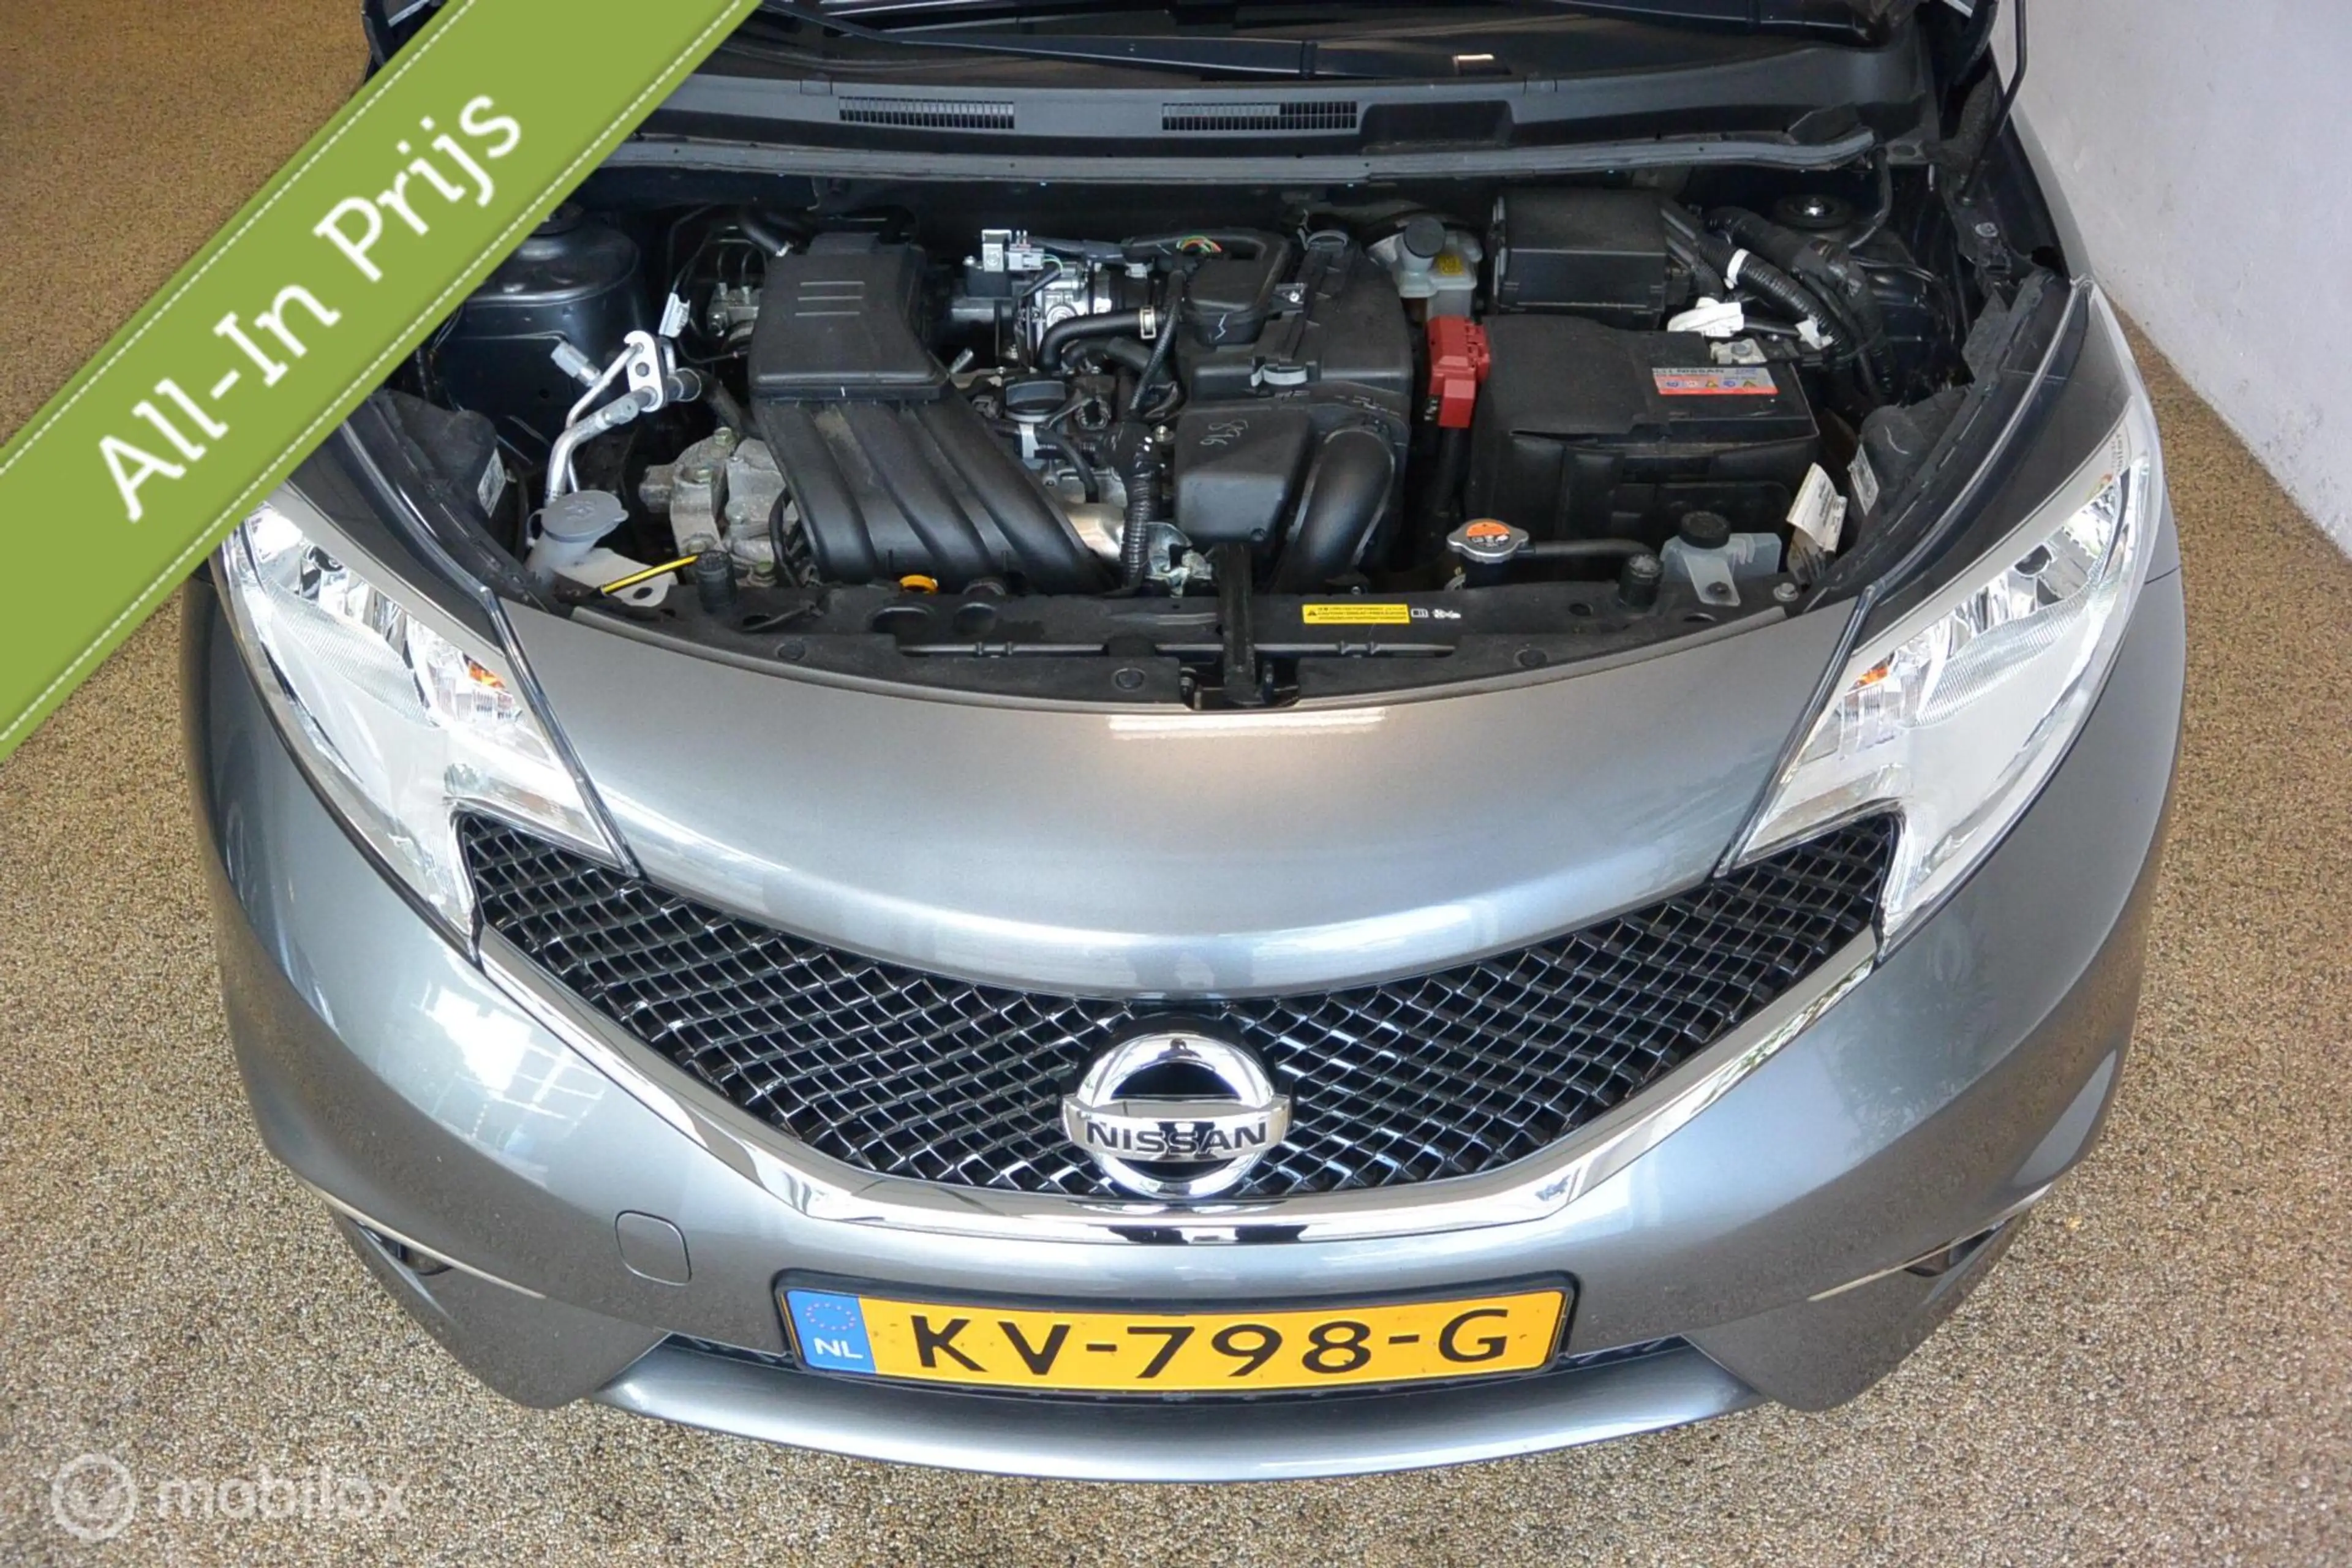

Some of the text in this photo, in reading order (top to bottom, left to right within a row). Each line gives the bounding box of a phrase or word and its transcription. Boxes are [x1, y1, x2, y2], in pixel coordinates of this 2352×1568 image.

[1086, 1121, 1267, 1153] NISSAN
[813, 1337, 863, 1359] NL
[913, 1310, 1506, 1377] KV-798-G
